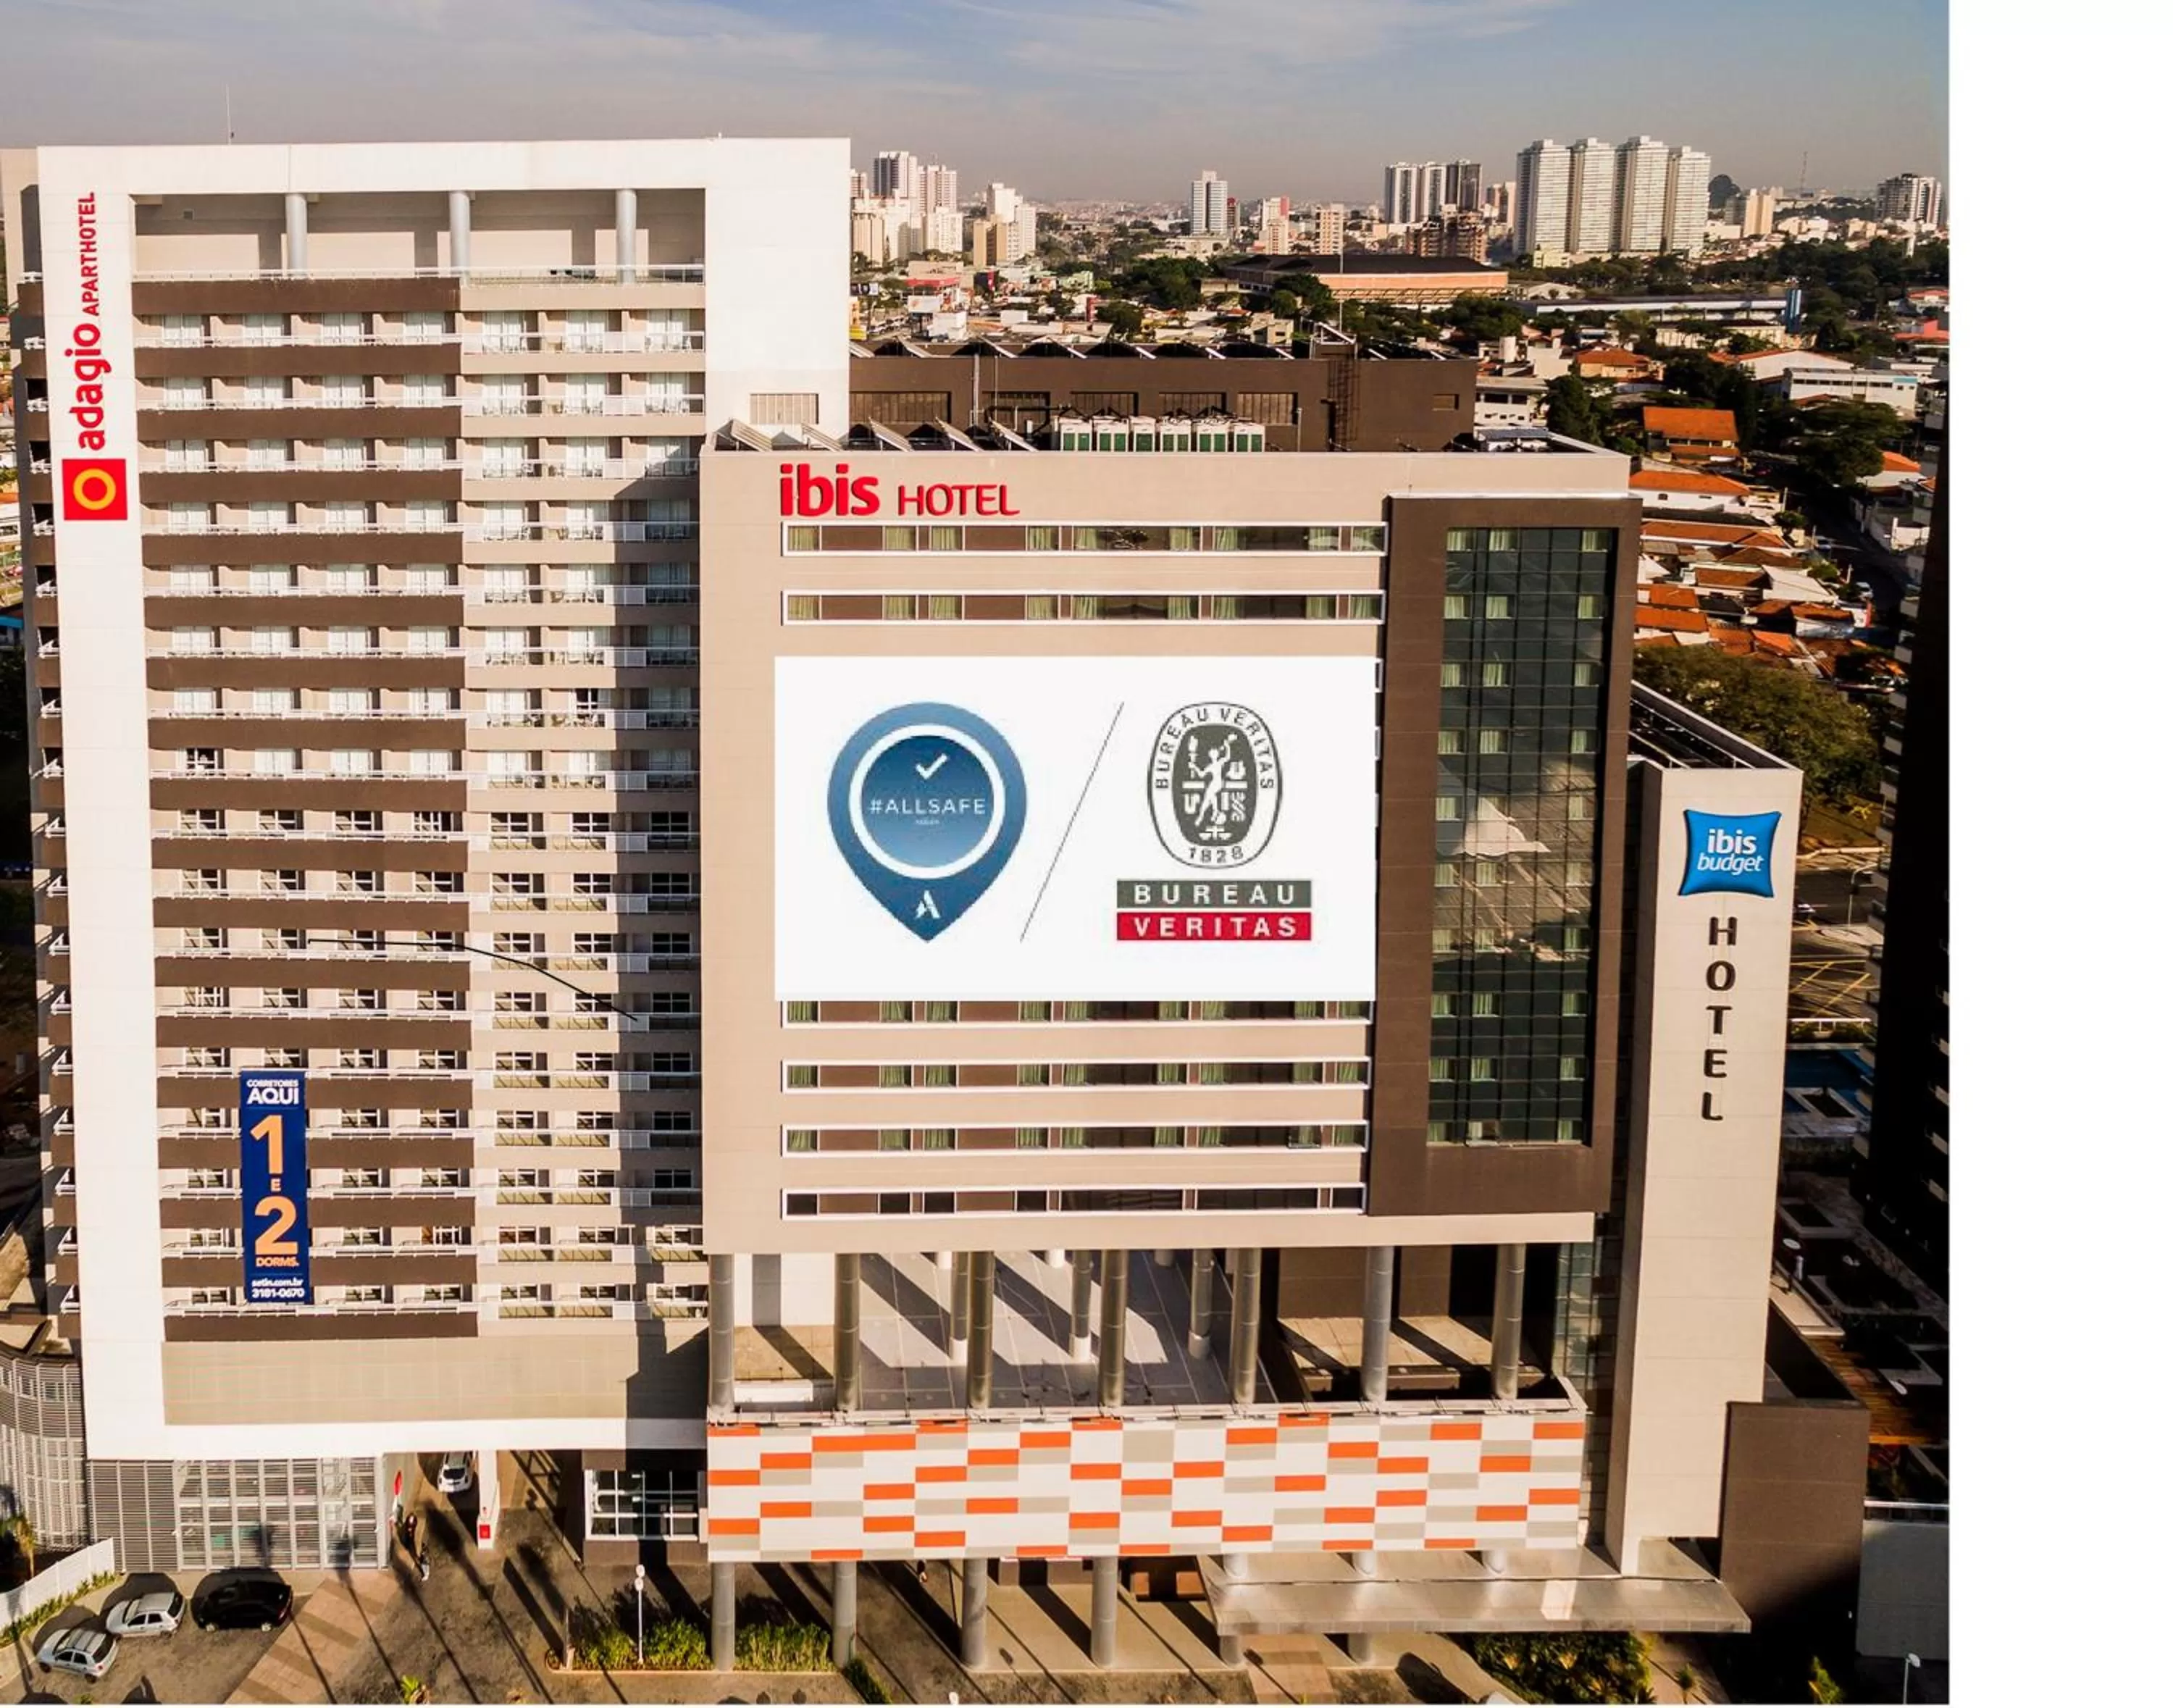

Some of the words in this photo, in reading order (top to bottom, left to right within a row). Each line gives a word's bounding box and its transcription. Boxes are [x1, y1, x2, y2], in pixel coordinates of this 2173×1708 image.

[78, 191, 100, 317] APARTHOTEL
[64, 323, 112, 451] adagio
[779, 464, 881, 516] ibis
[898, 483, 1020, 516] HOTEL
[1697, 853, 1765, 876] budget
[1707, 829, 1758, 855] ibis
[1701, 916, 1738, 1121] HOTEL
[246, 1087, 299, 1105] AQUI
[250, 1114, 283, 1175] 1
[270, 1178, 282, 1192] E
[254, 1196, 299, 1255] 2
